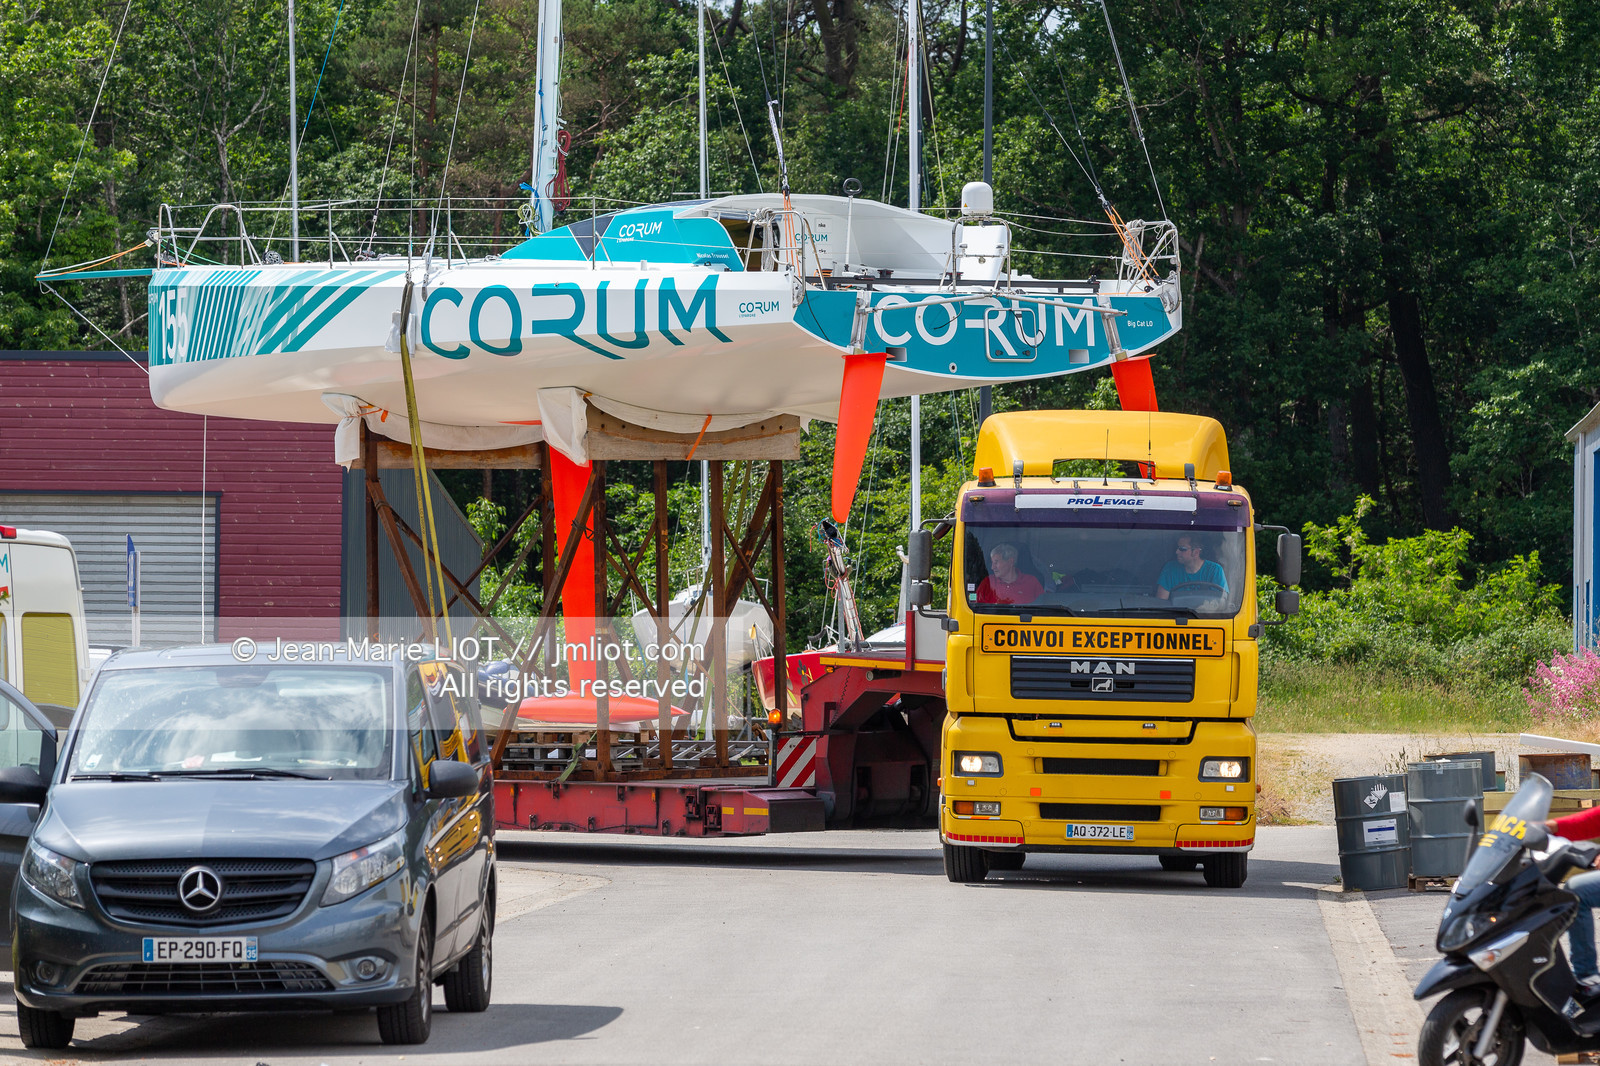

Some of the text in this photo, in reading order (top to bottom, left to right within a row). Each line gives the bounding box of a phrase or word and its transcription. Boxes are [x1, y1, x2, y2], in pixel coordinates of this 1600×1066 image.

[619, 221, 663, 238] CORUM
[421, 274, 733, 360] CORUM
[738, 301, 780, 315] CORUM
[159, 289, 189, 360] 155
[873, 294, 1096, 356] CORUM
[1127, 320, 1136, 329] Big
[993, 628, 1213, 651] CONVOI EXCEPTIONNEL
[1070, 661, 1136, 675] MAN
[1073, 825, 1126, 838] AQ-372-LE
[157, 940, 243, 960] EP-290-FQ
[246, 949, 257, 959] 35
